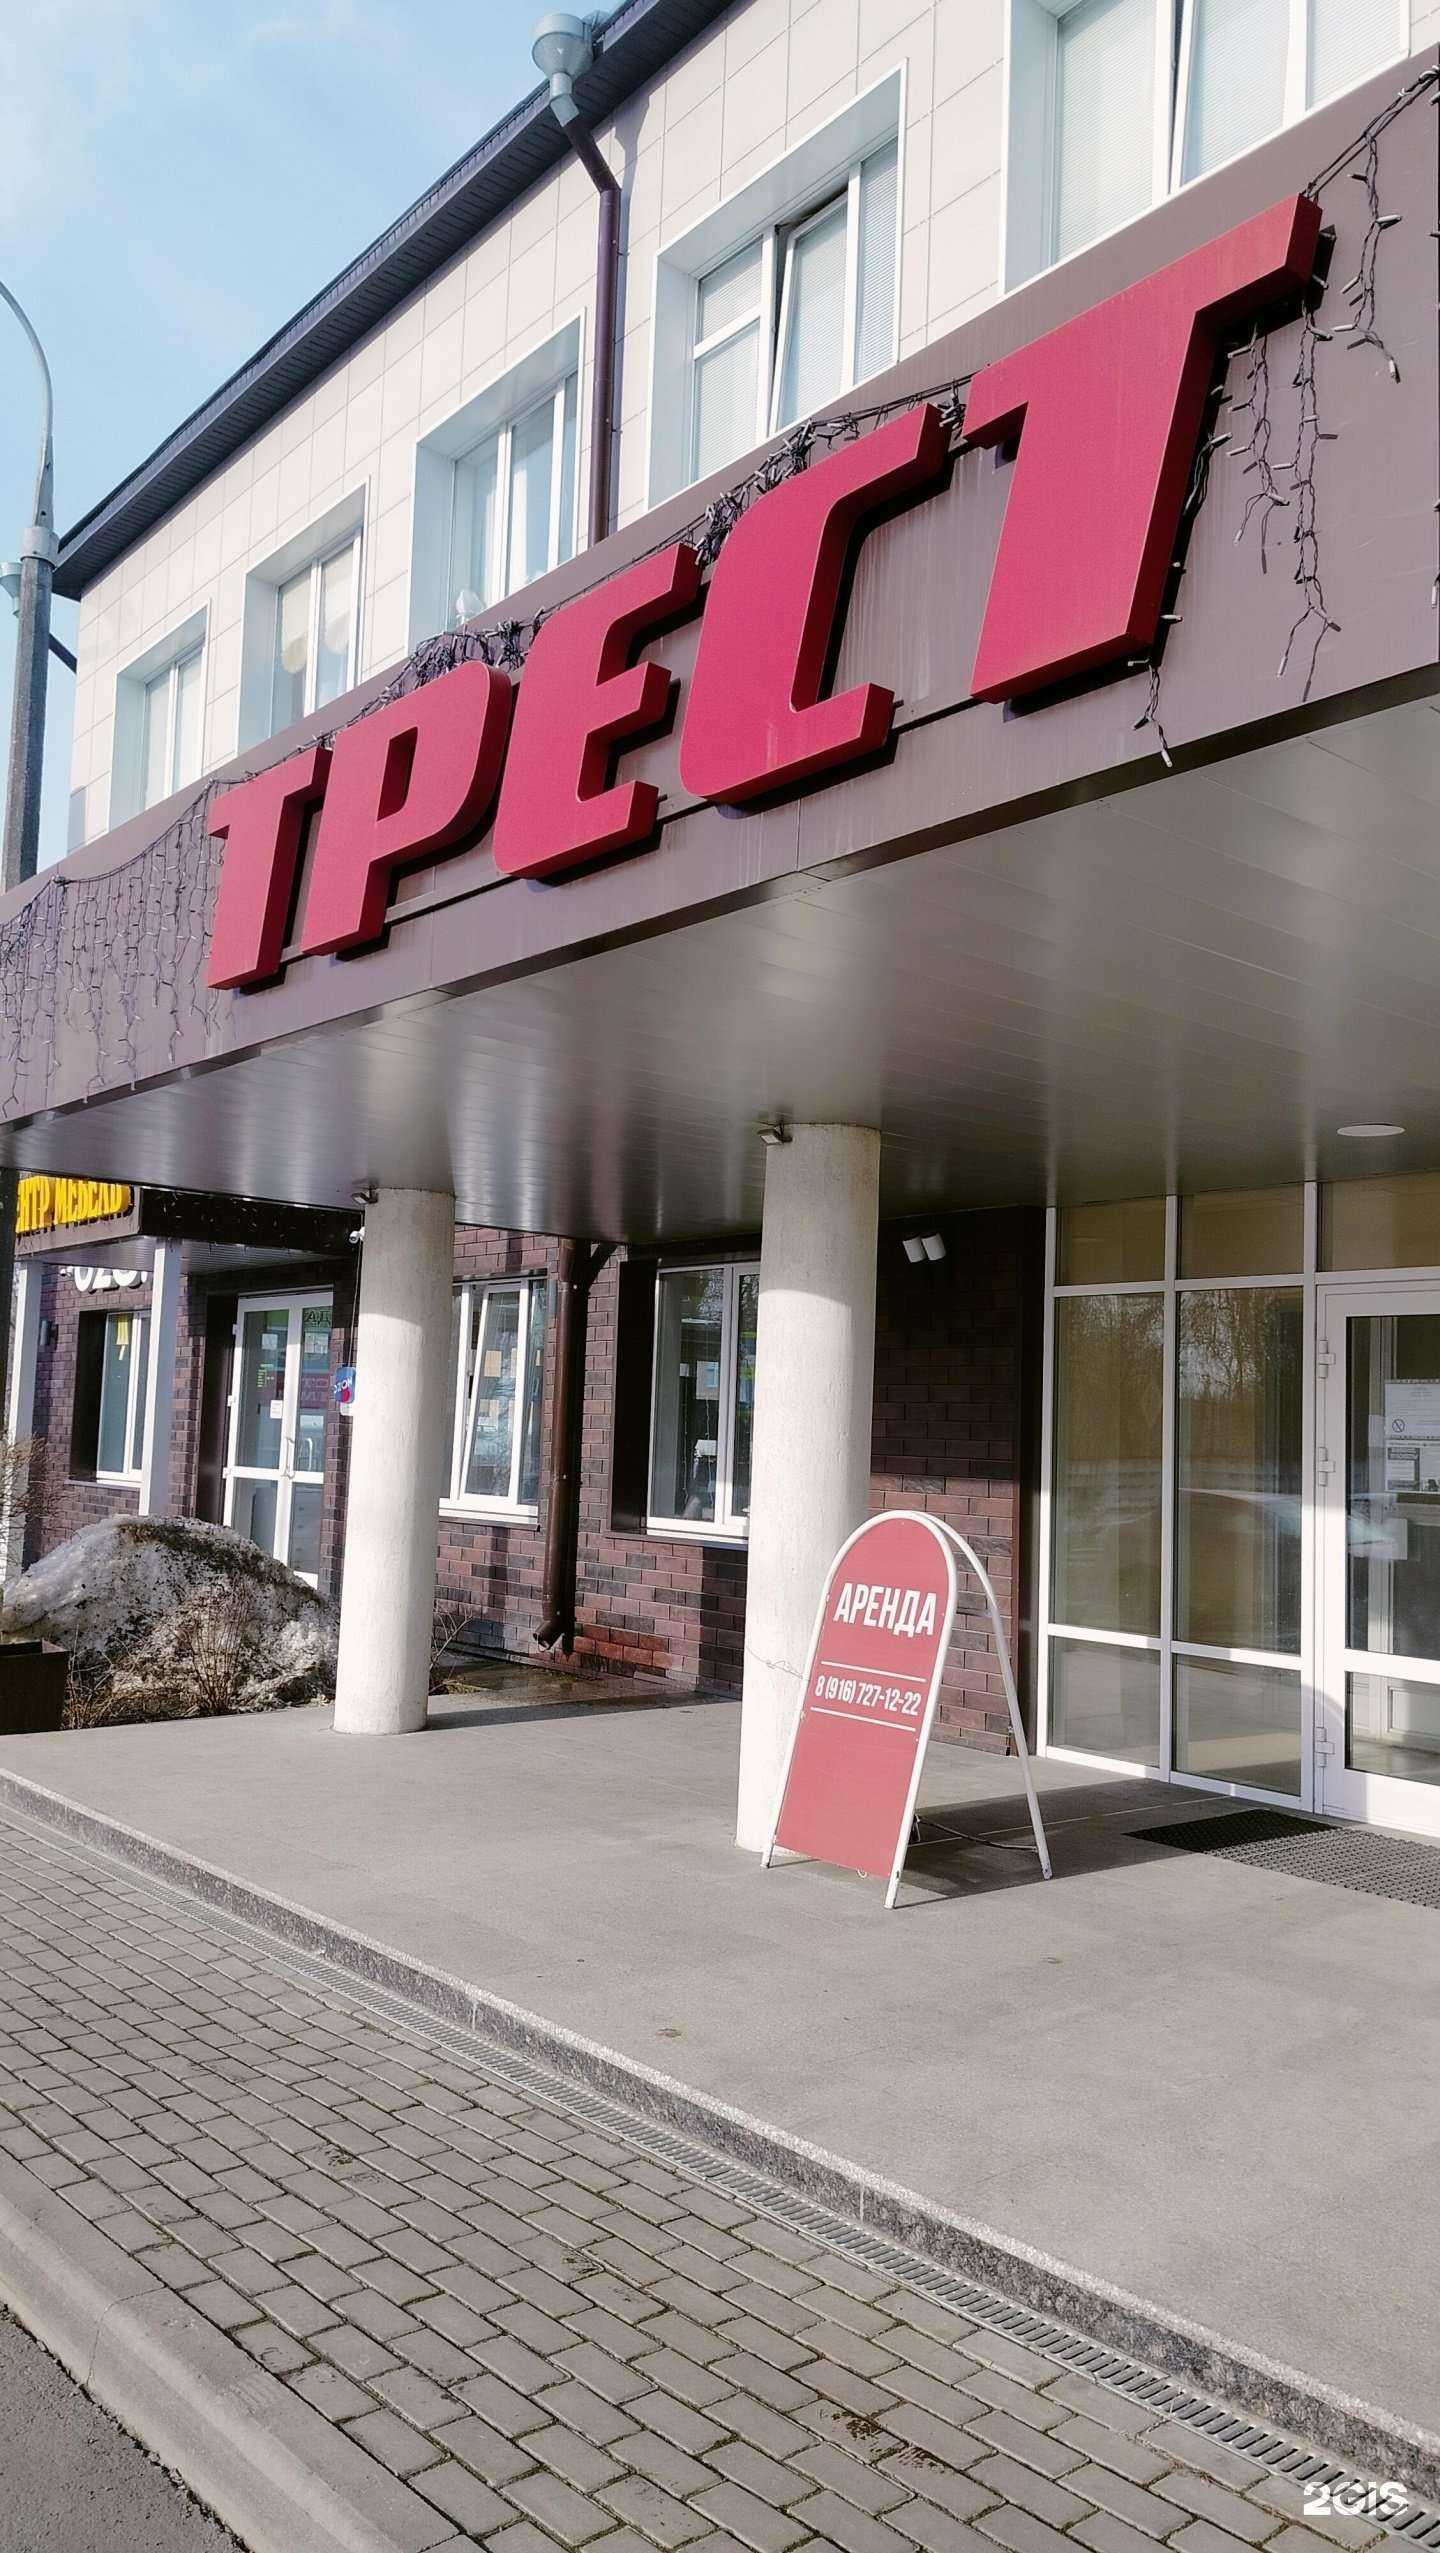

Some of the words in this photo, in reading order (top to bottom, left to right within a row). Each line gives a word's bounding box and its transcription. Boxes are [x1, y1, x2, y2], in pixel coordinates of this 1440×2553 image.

[206, 192, 1322, 990] ТРЕСТ
[16, 1176, 51, 1233] НТР
[832, 1582, 937, 1638] АРЕНДА
[814, 1675, 824, 1697] 8
[825, 1677, 857, 1704] (916)
[858, 1682, 922, 1716] 727-12-22
